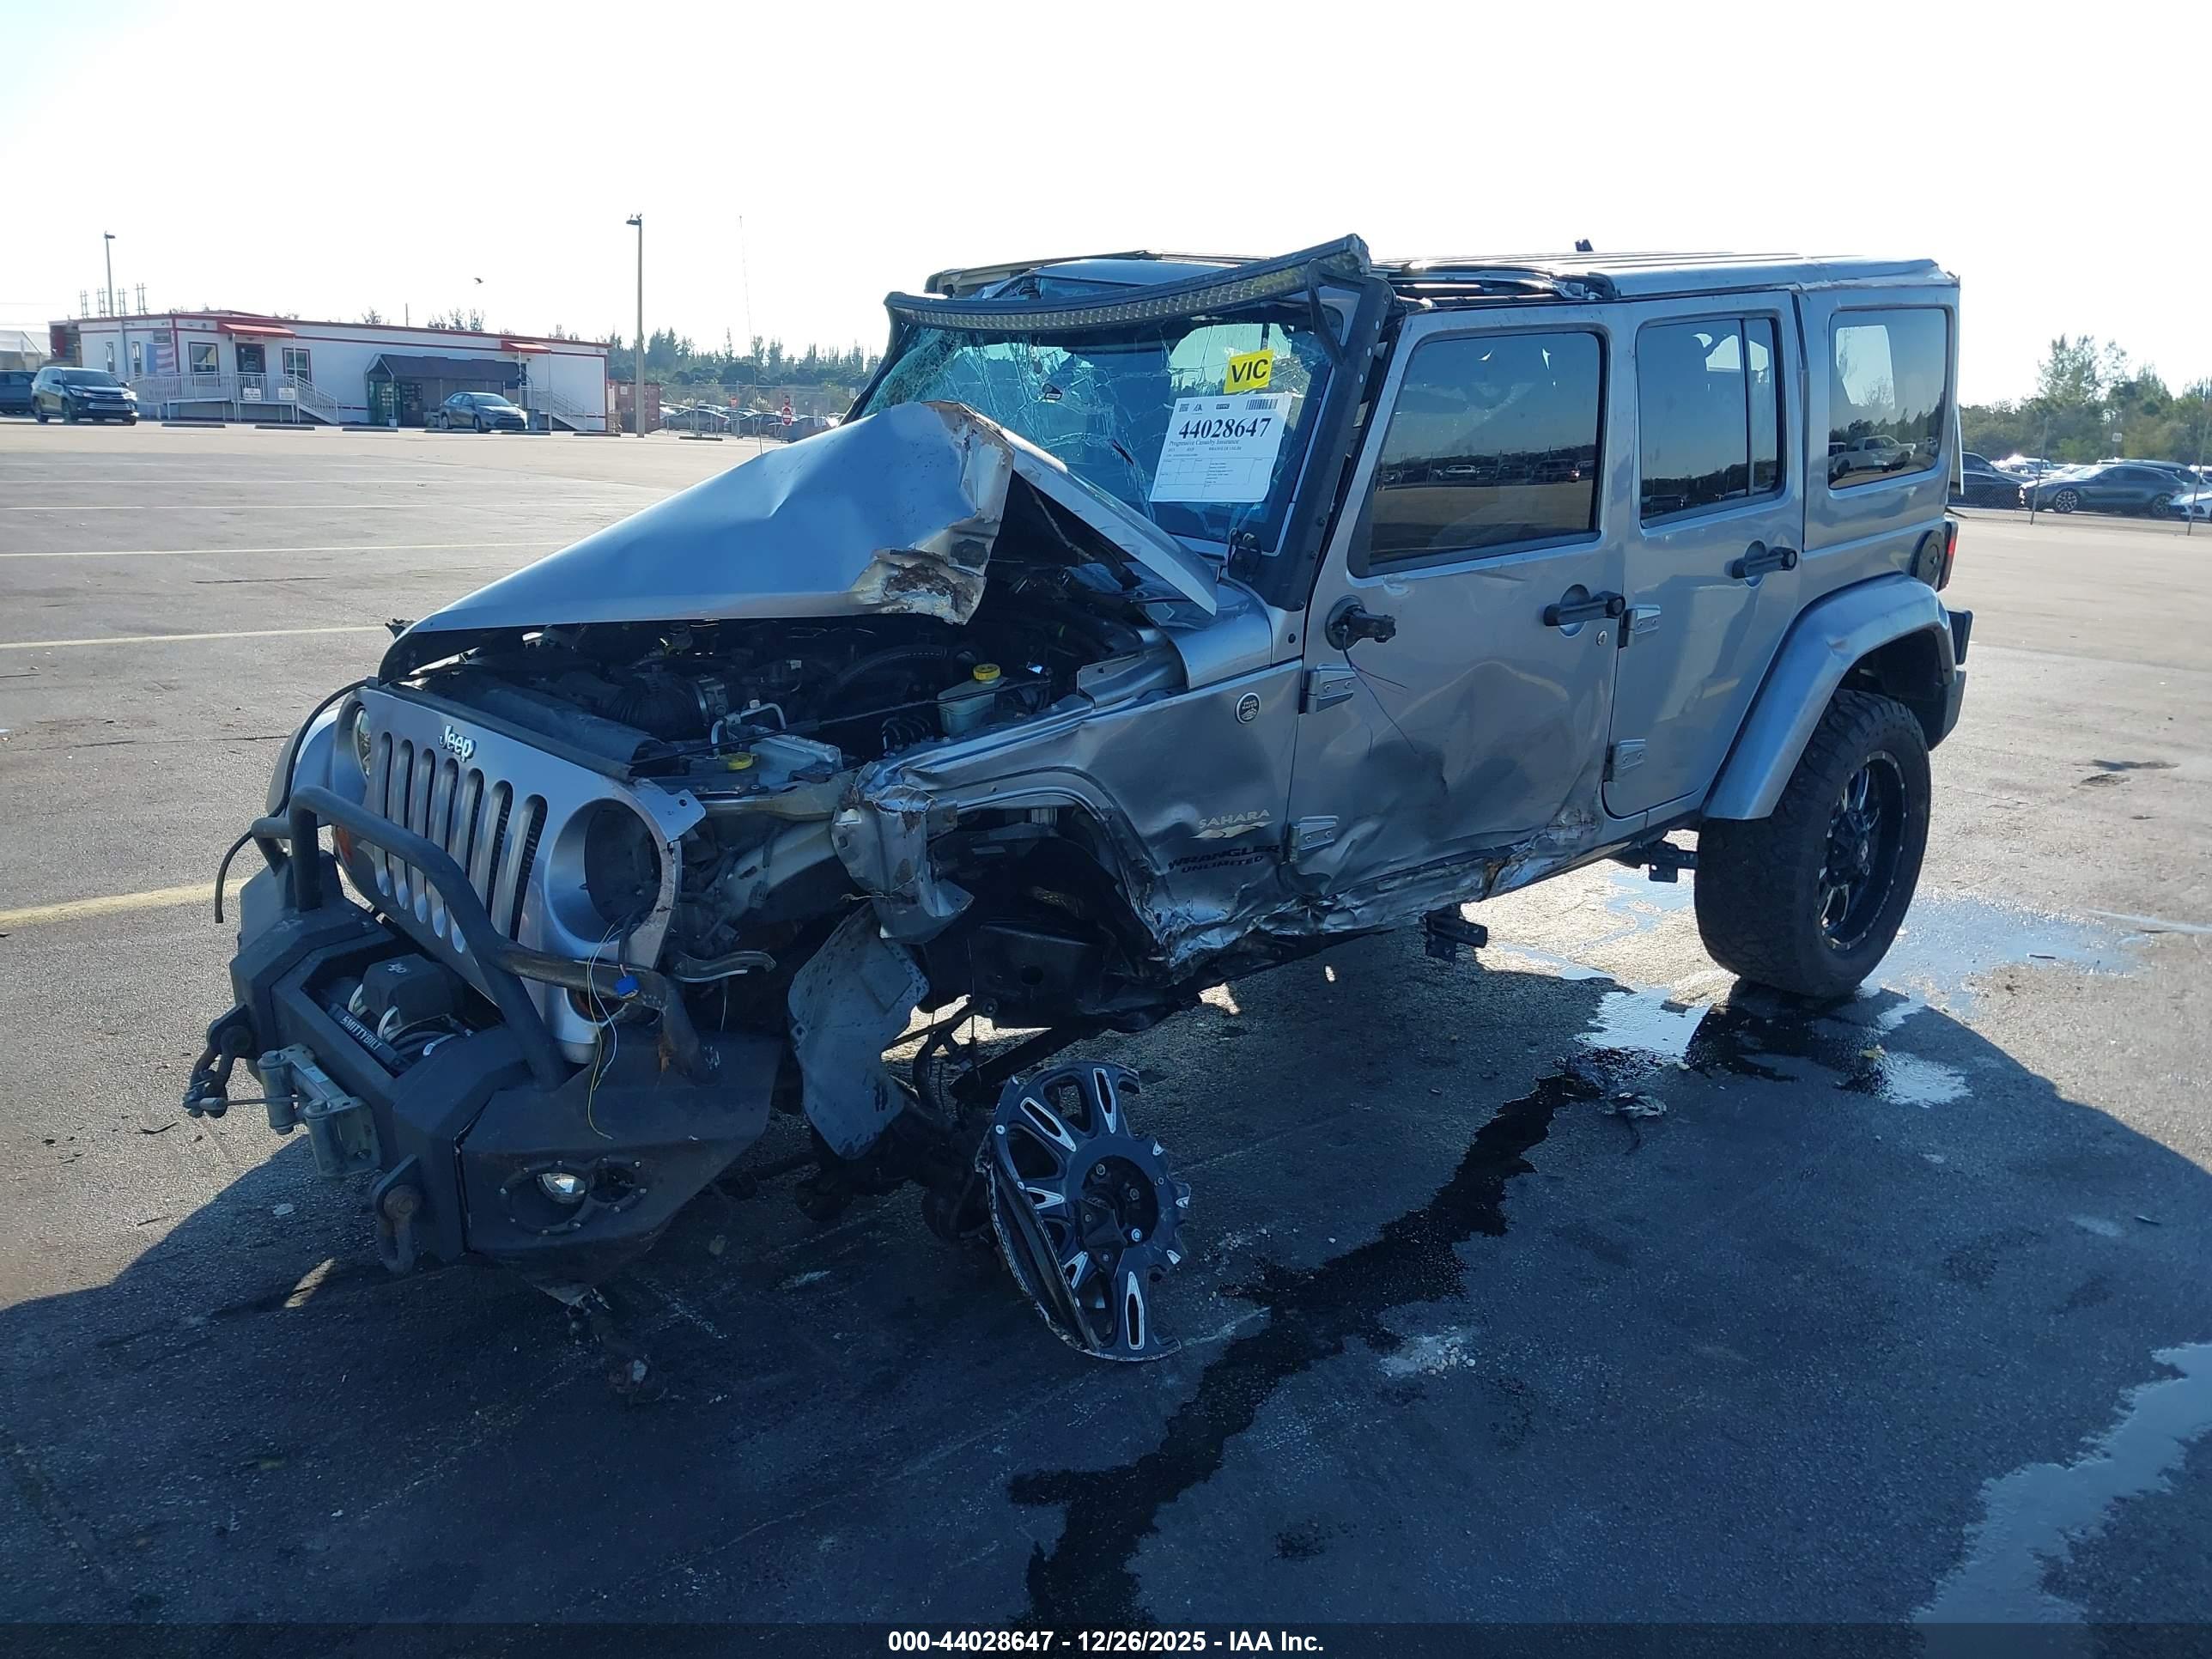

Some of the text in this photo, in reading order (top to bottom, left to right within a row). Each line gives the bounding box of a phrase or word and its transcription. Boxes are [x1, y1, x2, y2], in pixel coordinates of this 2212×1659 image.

[1231, 359, 1269, 383] VIC
[1179, 417, 1272, 439] 44028647
[439, 725, 474, 763] Jeep
[1199, 809, 1270, 829] SAHARA
[1168, 845, 1279, 870] WRANGLER
[1182, 855, 1263, 872] UNLIMITED
[340, 1015, 383, 1051] SMITTYBILT
